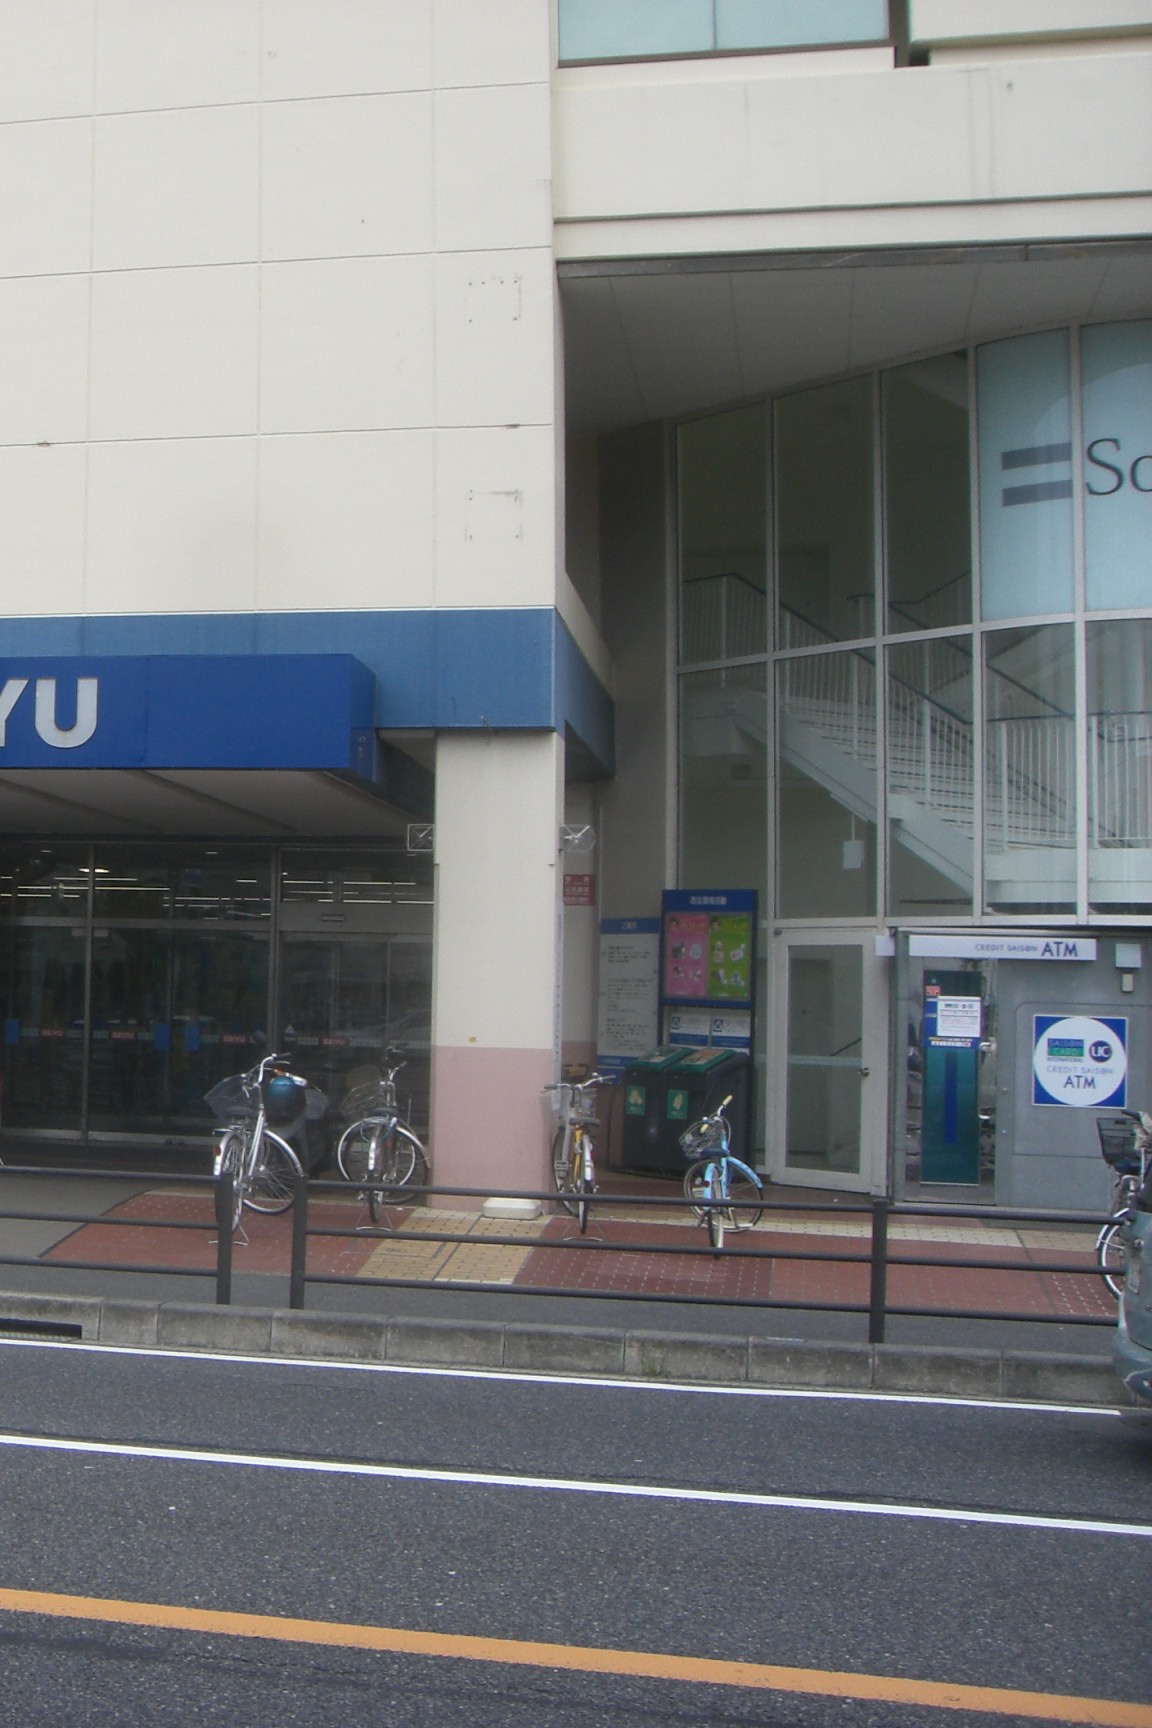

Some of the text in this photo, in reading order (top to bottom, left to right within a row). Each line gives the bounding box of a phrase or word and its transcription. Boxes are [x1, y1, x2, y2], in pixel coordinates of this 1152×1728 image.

[975, 943, 1004, 952] CREDIT
[1041, 941, 1078, 957] ATM
[1090, 1045, 1111, 1058] UC
[1046, 1065, 1078, 1074] CREDIT
[1063, 1074, 1096, 1090] ATM
